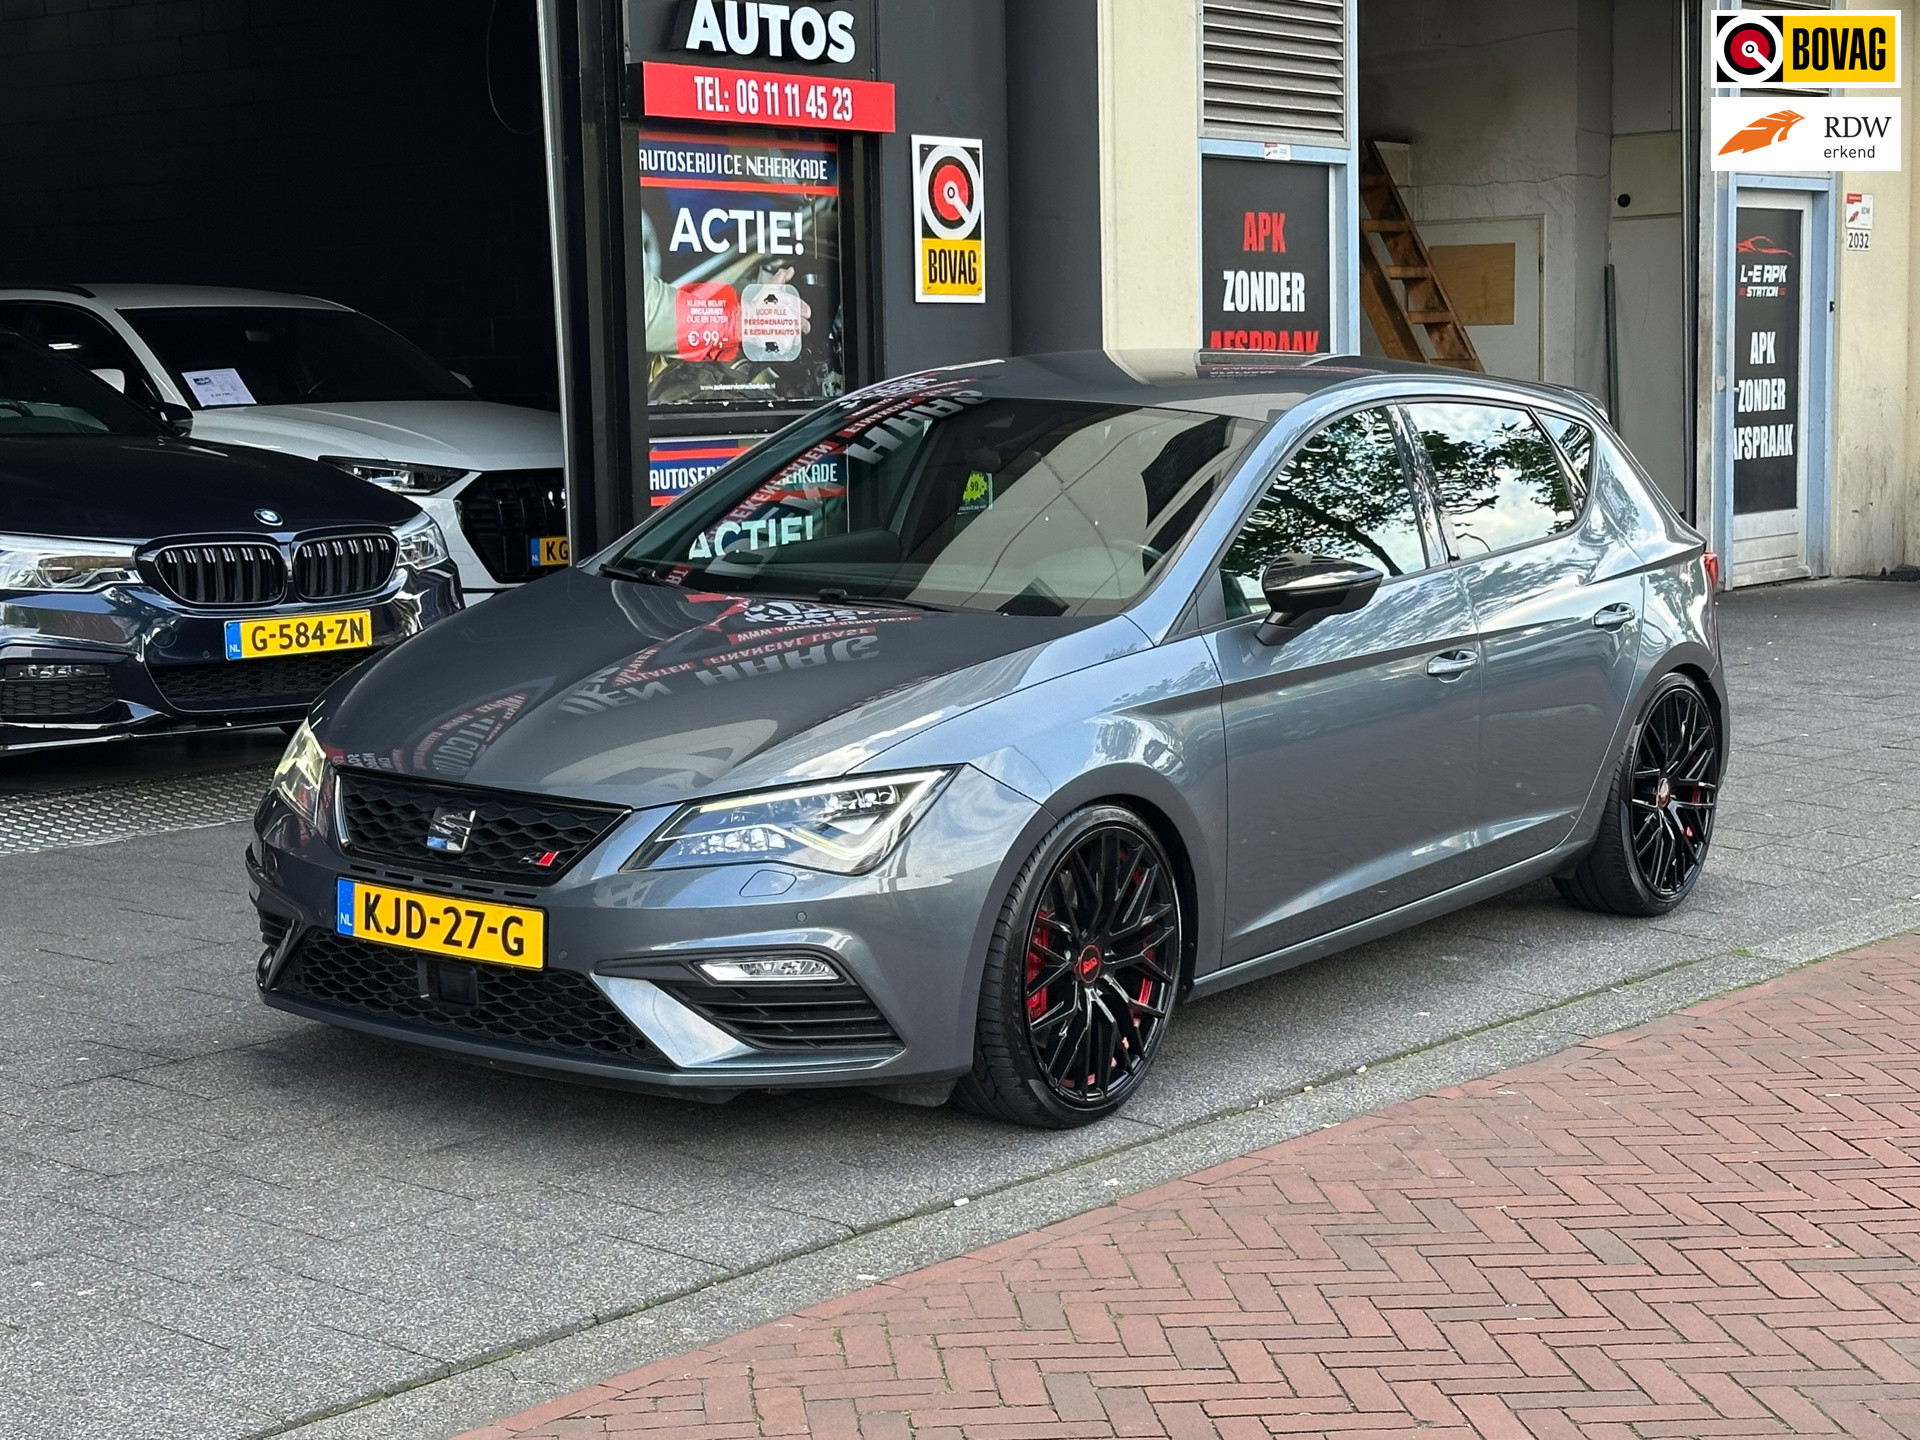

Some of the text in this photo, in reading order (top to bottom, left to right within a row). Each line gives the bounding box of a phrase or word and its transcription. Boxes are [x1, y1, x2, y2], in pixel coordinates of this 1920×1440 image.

[684, 0, 856, 64] AUTOS
[693, 75, 853, 122] TEL: 06 11 11 45 23
[639, 149, 828, 180] AUTOSERVICE NEHERKADE
[669, 207, 804, 256] ACTIE!
[1243, 211, 1287, 253] APK
[1848, 232, 1870, 249] 2032
[928, 248, 977, 285] BOVAG
[1740, 264, 1788, 283] L-E APK
[1222, 270, 1306, 312] ZONDER
[1746, 286, 1779, 297] STATION
[687, 330, 729, 349] € 99,-
[1750, 331, 1776, 364] APK
[1738, 378, 1786, 413] ZONDER
[229, 617, 364, 653] NL G-584-ZN
[340, 892, 525, 957] NL KJD-27-G
